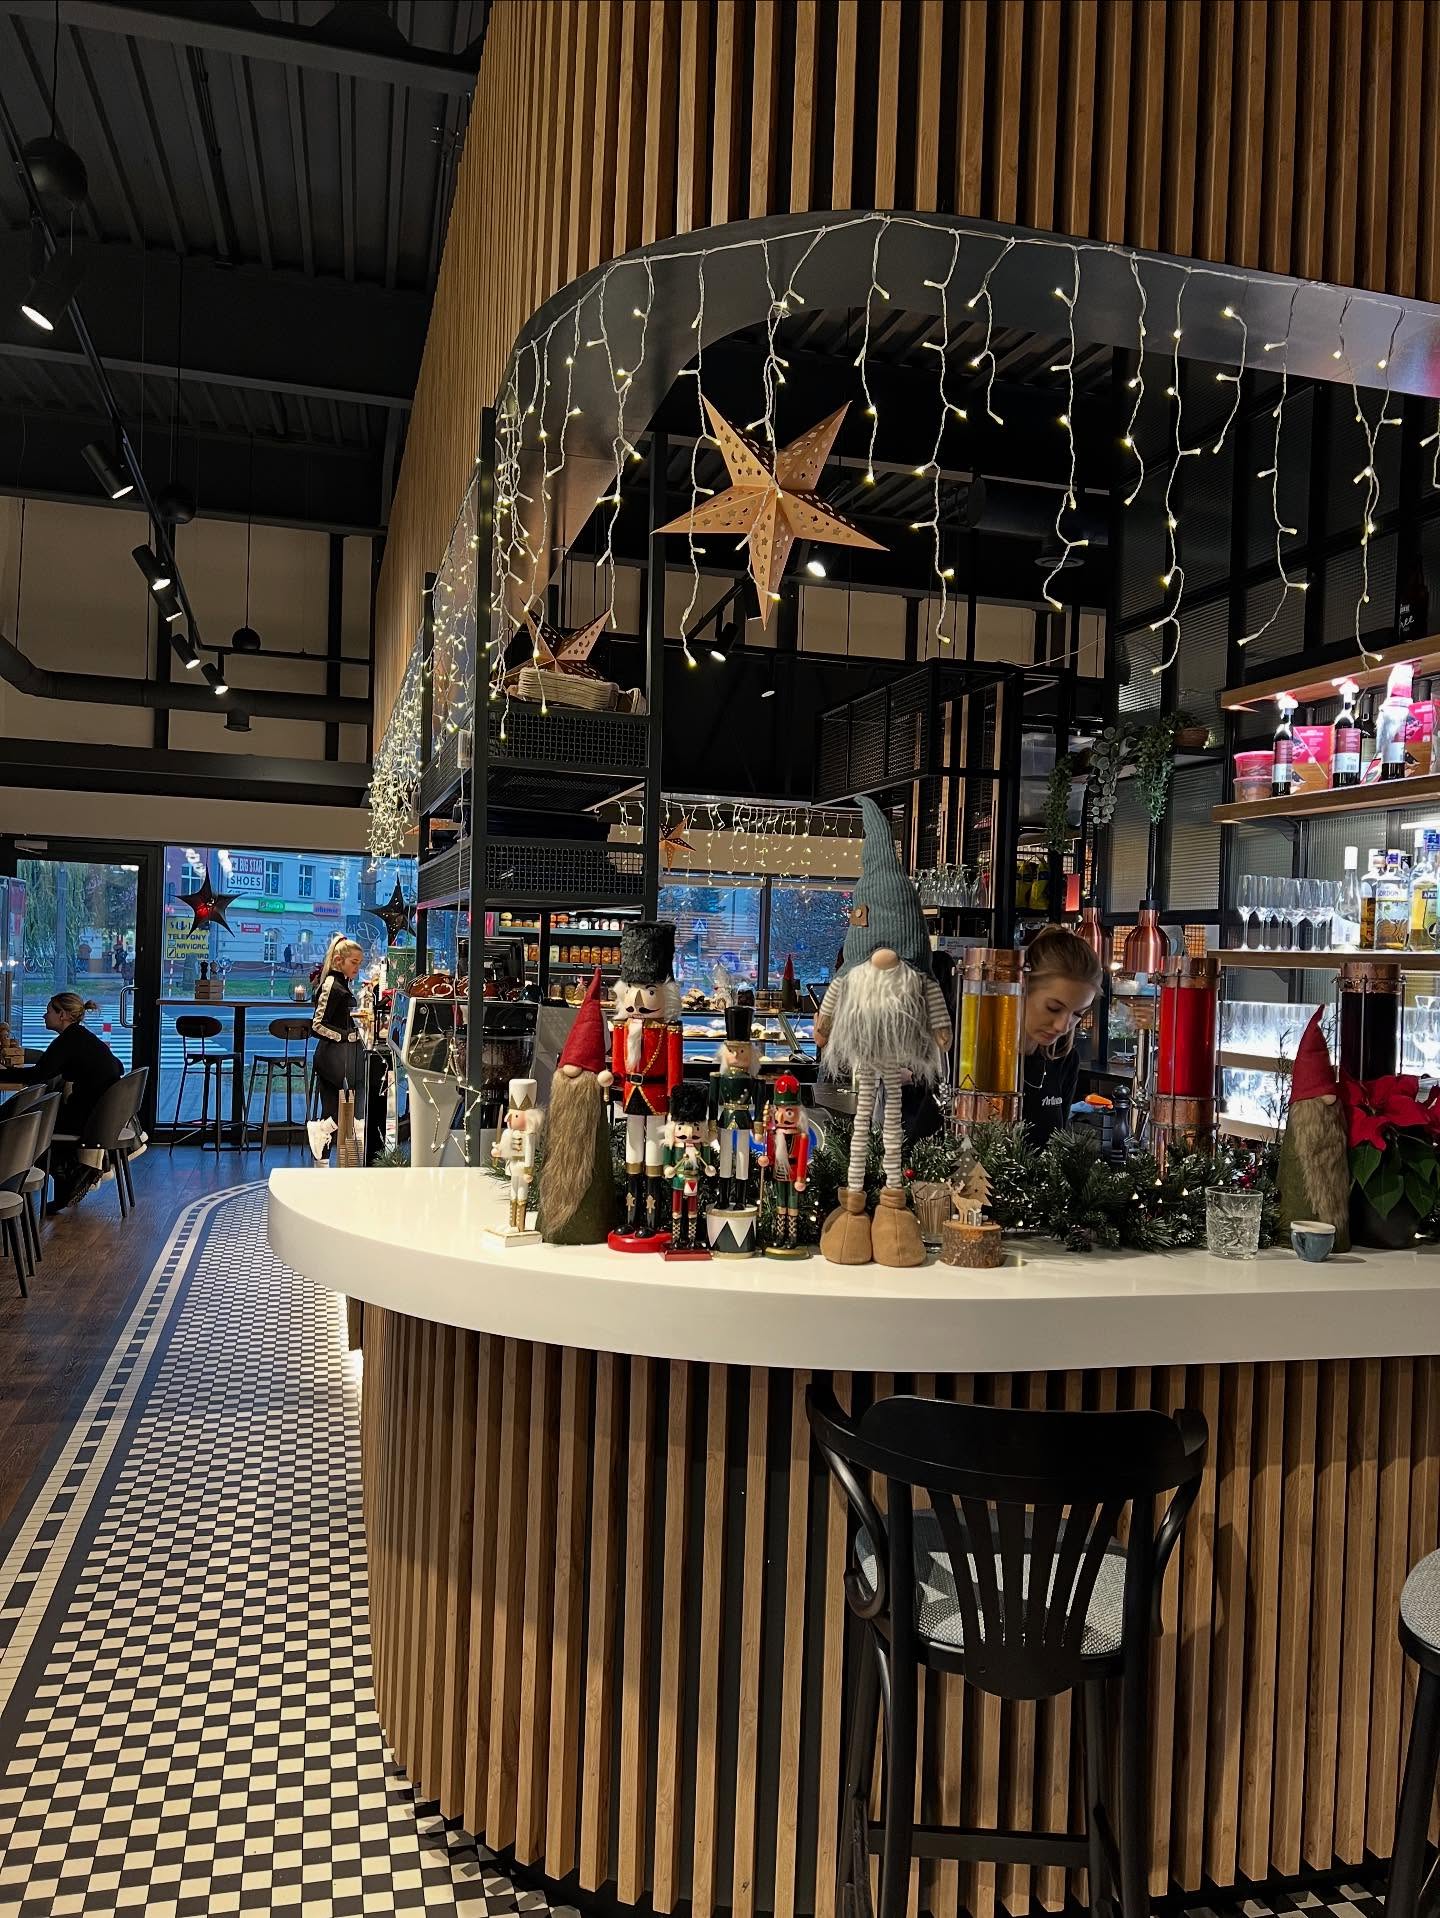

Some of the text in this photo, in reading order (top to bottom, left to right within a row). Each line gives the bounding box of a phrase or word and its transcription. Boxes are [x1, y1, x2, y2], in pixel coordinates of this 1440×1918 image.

[240, 858, 263, 874] BIG STAR
[230, 875, 261, 886] SHOES
